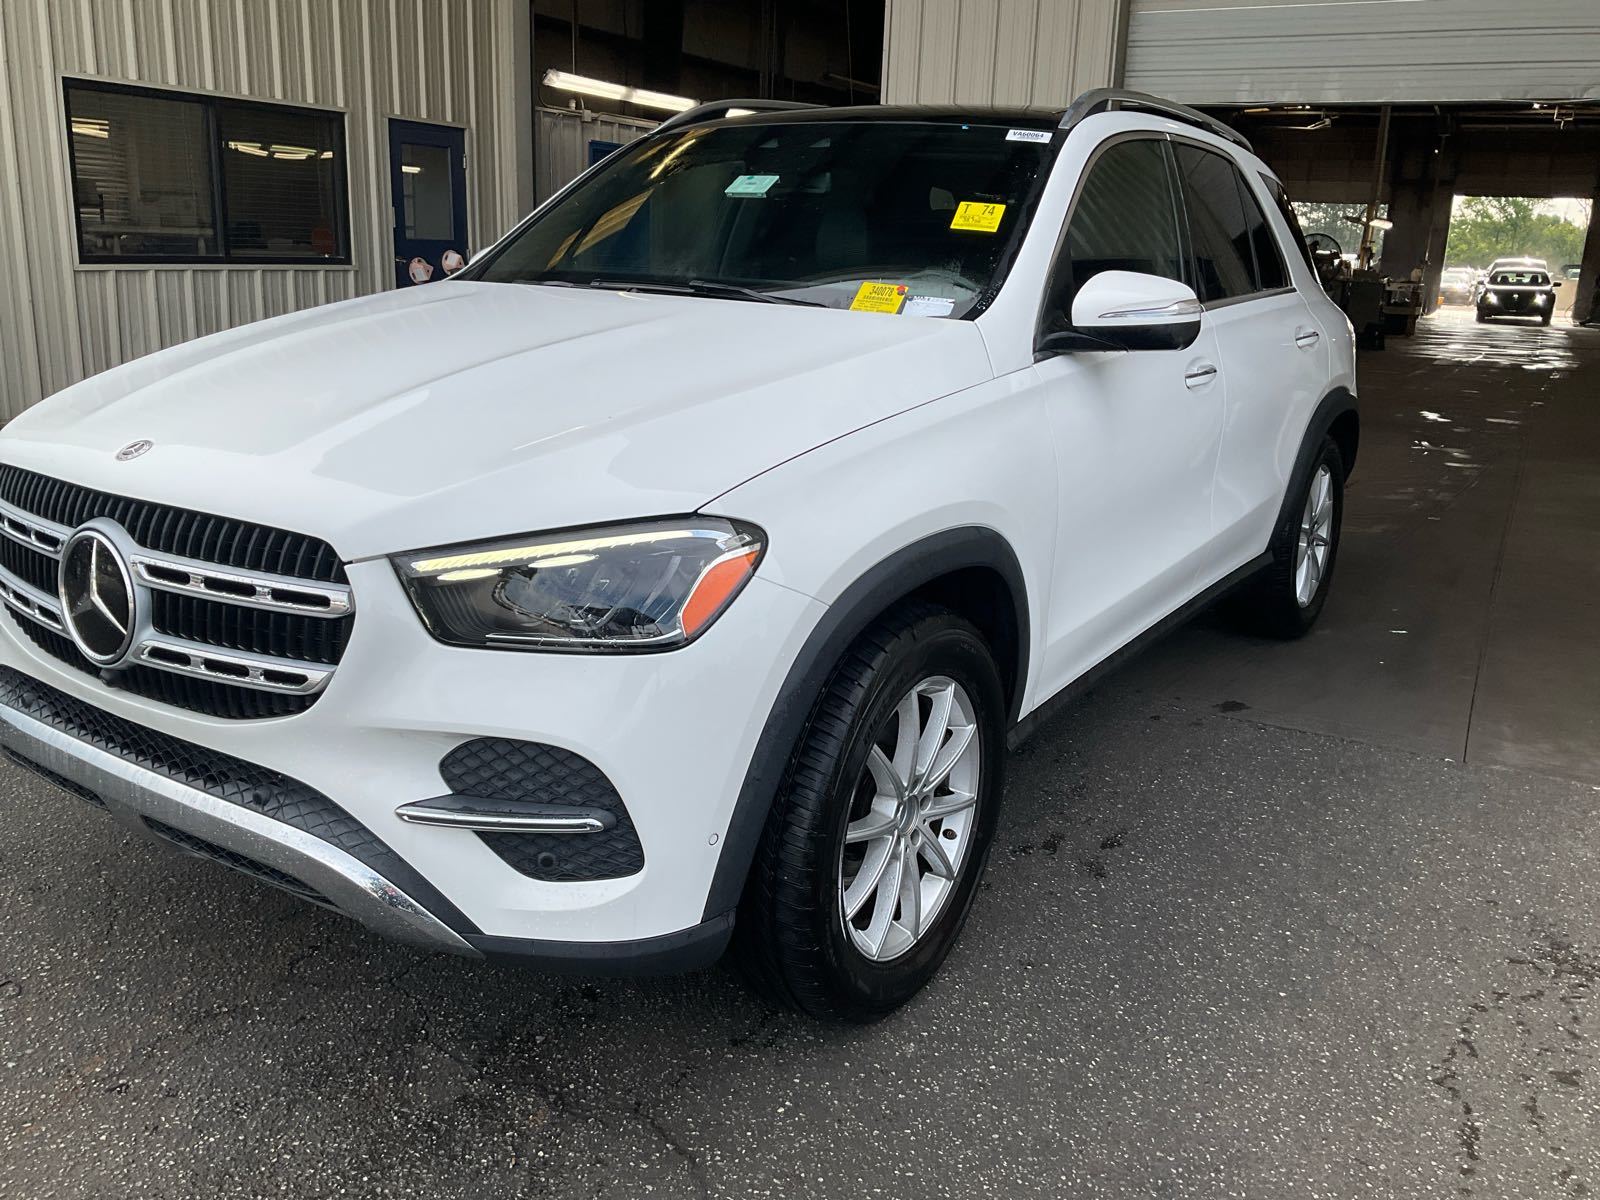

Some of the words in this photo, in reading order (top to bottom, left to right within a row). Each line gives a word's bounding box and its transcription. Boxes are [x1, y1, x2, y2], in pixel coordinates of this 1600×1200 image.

[1012, 130, 1045, 138] VA60064
[981, 205, 996, 216] 74
[869, 285, 895, 297] 340078
